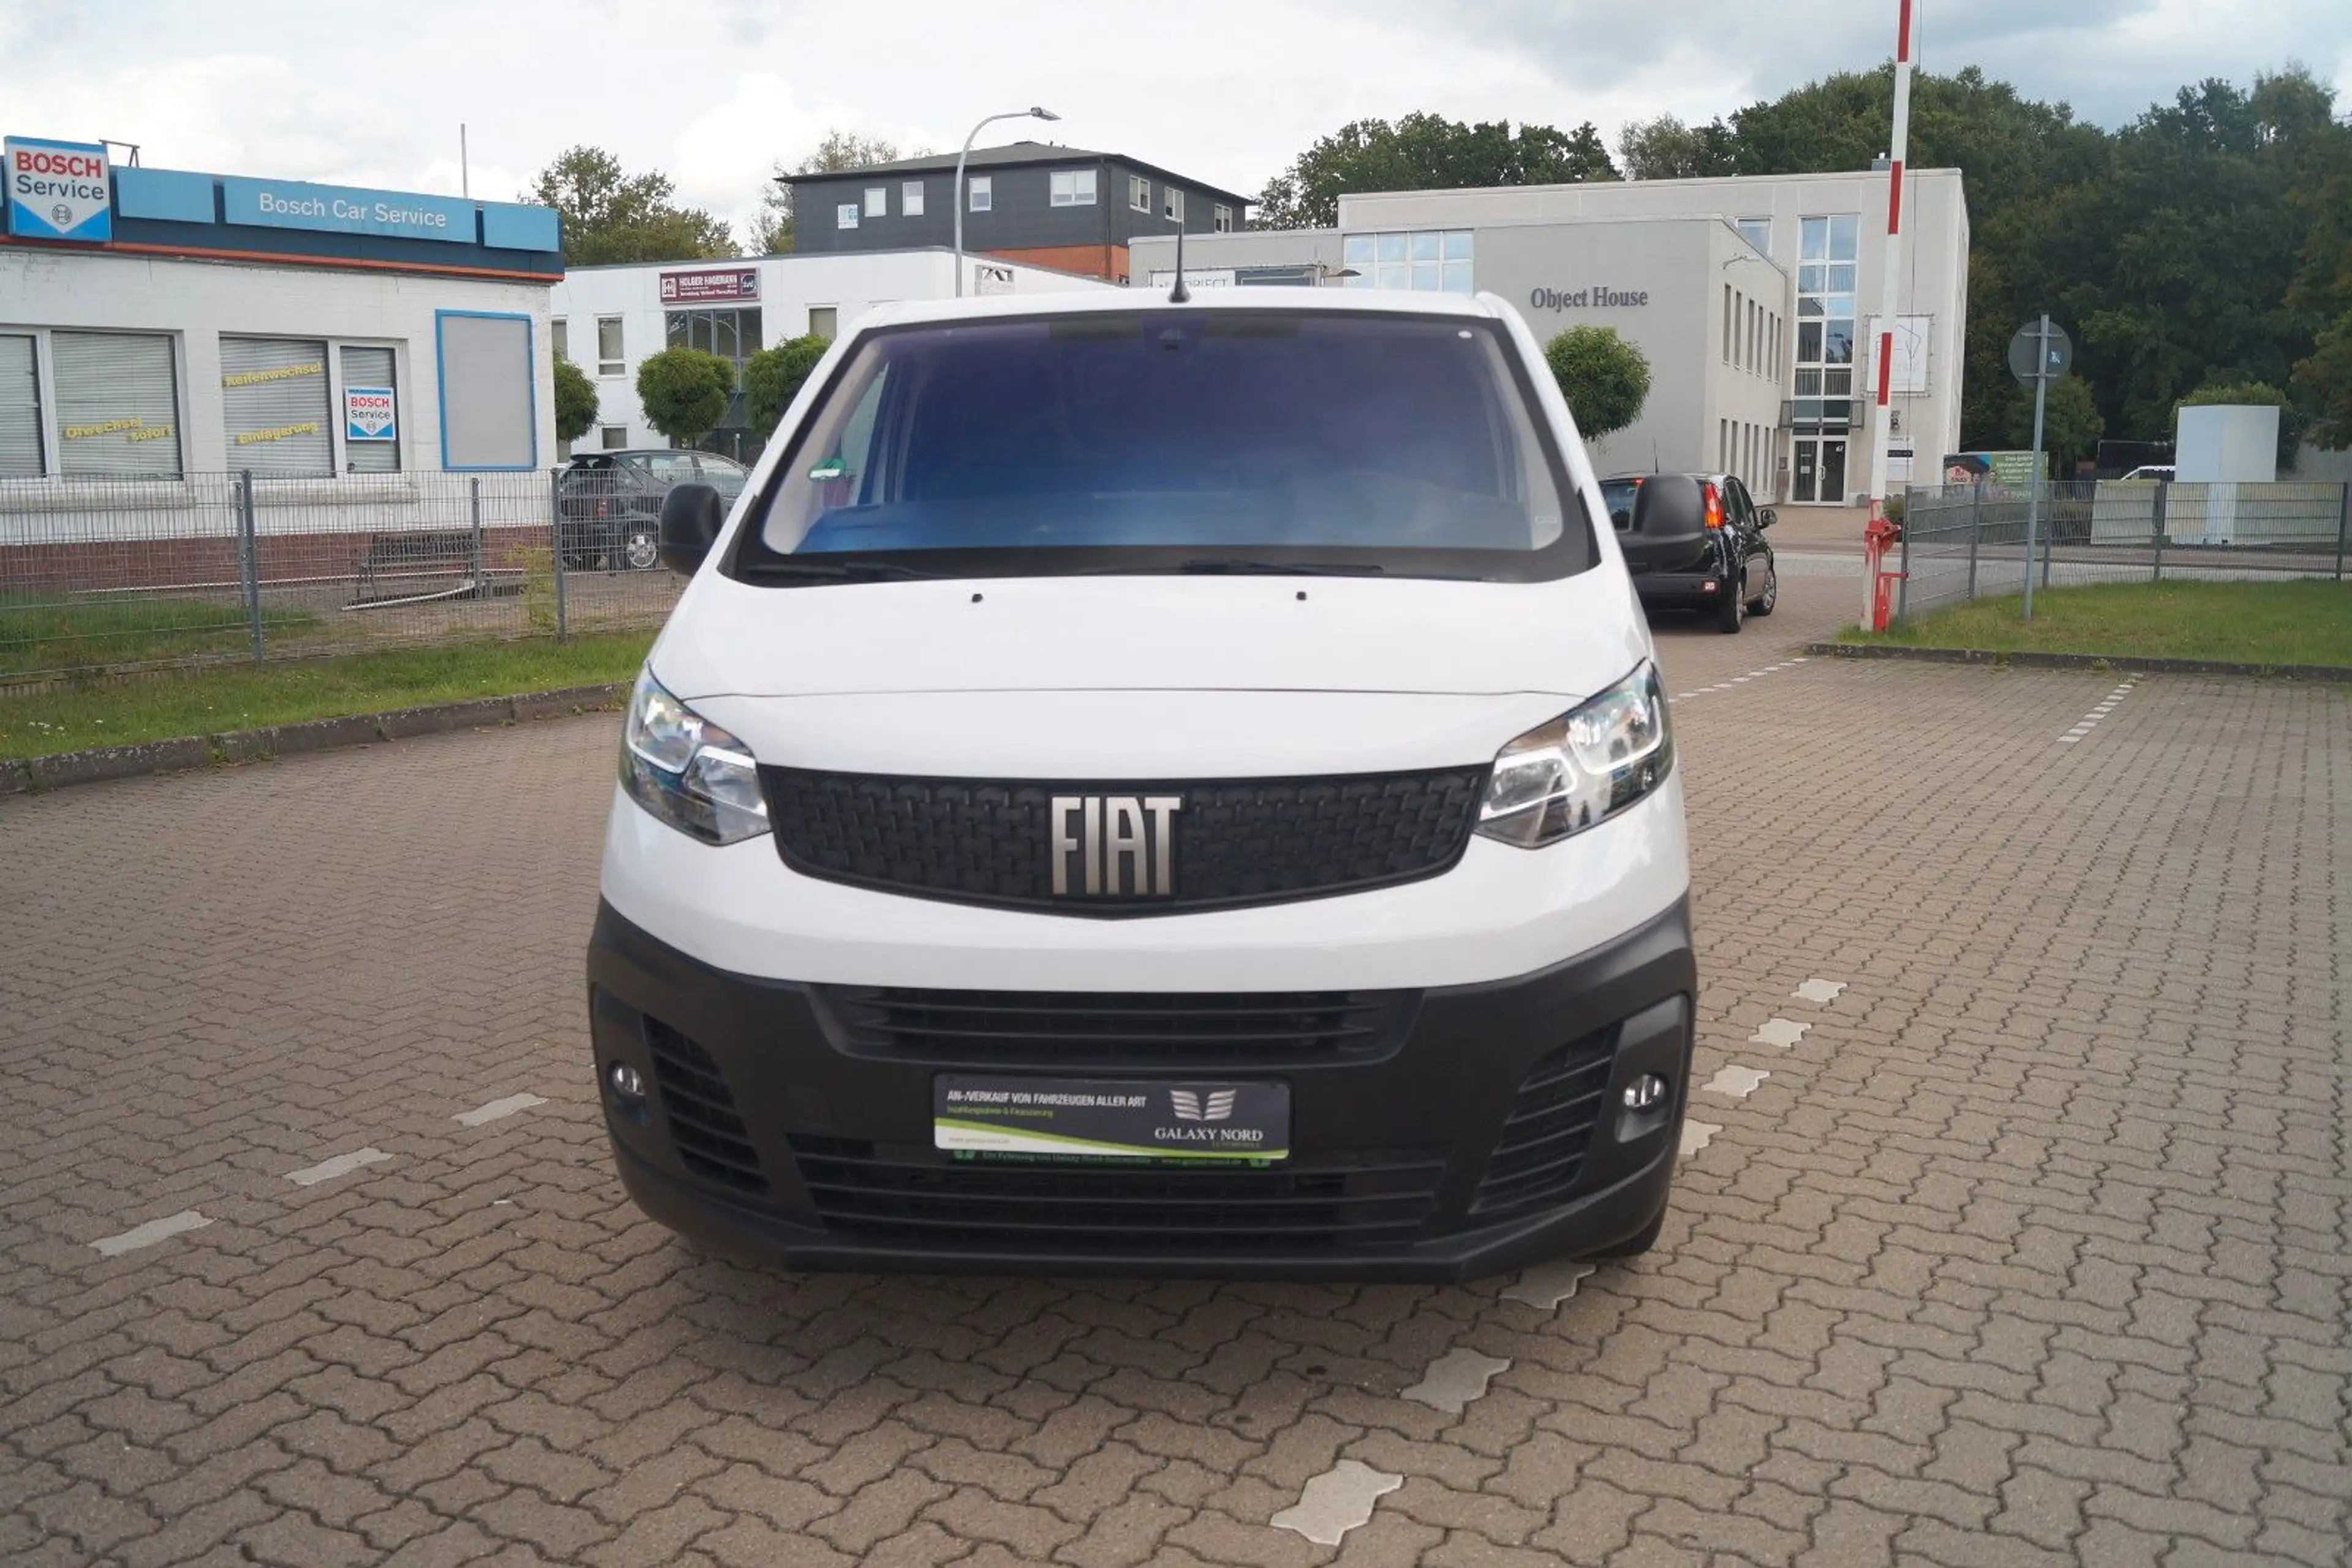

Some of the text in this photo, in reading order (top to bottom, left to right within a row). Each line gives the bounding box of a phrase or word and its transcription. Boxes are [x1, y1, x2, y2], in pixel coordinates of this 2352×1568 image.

[16, 151, 102, 178] BOSCH
[17, 174, 104, 200] Service
[259, 192, 447, 227] Bosch Car Service
[1531, 286, 1648, 313] Object House
[351, 396, 390, 407] BOSCH
[351, 409, 390, 420] Service
[1051, 796, 1181, 895] FIAT
[1011, 1092, 1031, 1104] VON
[1033, 1093, 1095, 1106] FAHRZEUGEN
[1096, 1095, 1126, 1107] ALLER
[1127, 1096, 1147, 1107] ART
[1155, 1126, 1264, 1142] GALAXY NORD
